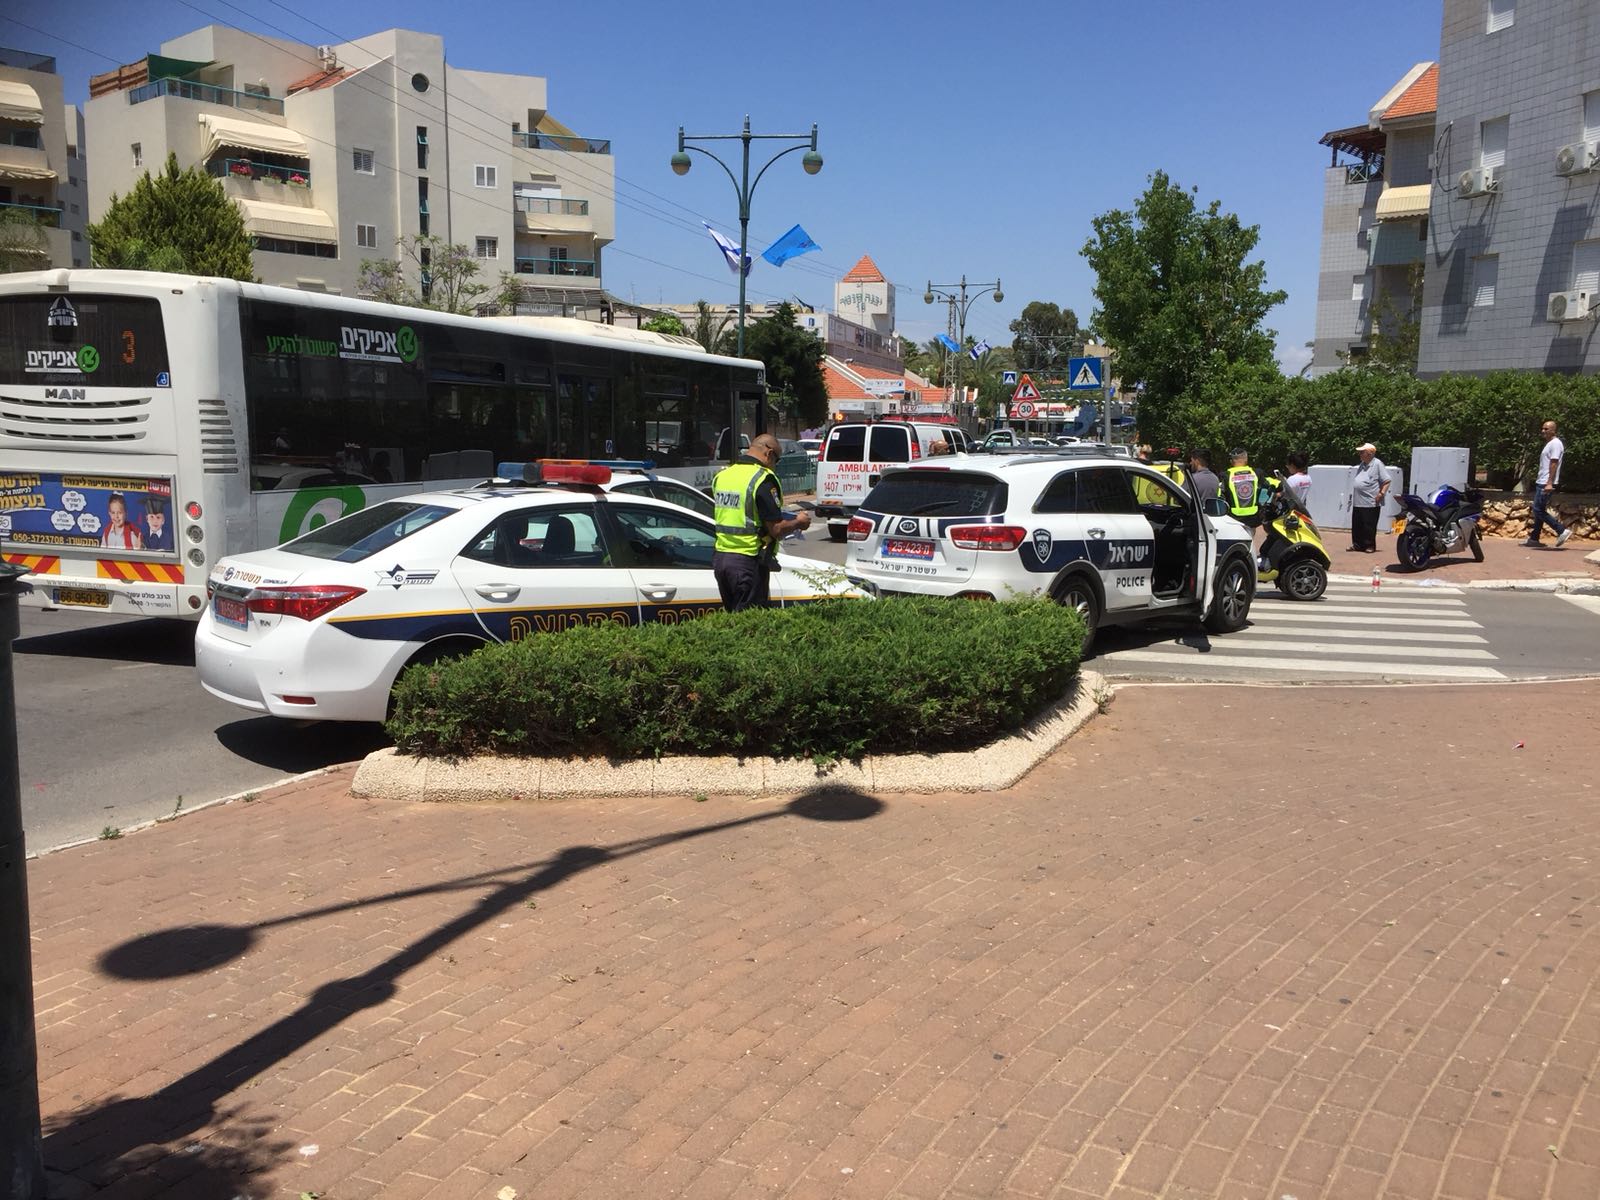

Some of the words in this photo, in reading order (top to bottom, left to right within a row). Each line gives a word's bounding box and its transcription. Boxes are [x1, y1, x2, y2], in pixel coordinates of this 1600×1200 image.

[122, 329, 136, 364] 3
[266, 334, 302, 355] להגיע
[304, 338, 338, 357] פשוט
[45, 388, 86, 400] MAN
[1021, 405, 1032, 414] 30
[838, 463, 897, 473] AMBULAN
[824, 482, 839, 492] 1407
[12, 533, 64, 545] 050-3723708
[1109, 542, 1149, 563] ישראל
[880, 561, 904, 571] ישראל
[907, 564, 937, 575] משטרת
[233, 570, 262, 585] משטרה
[1116, 576, 1145, 588] POLICE
